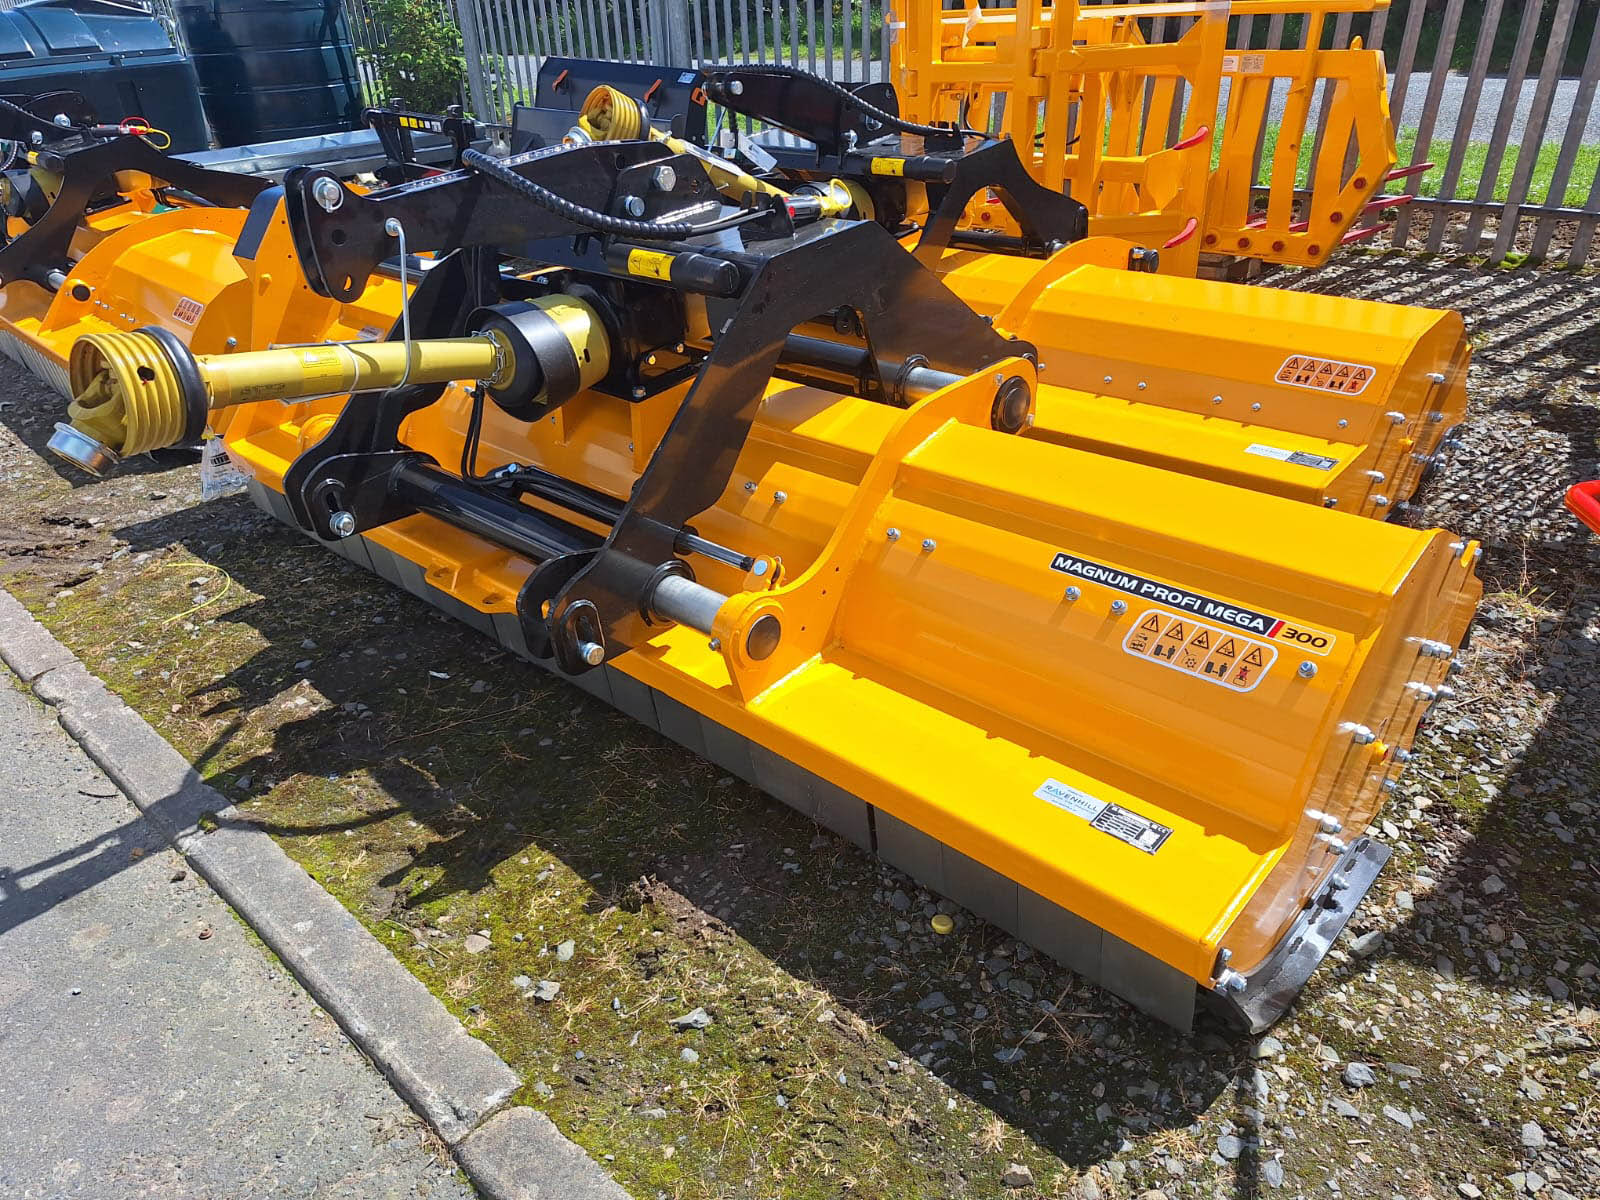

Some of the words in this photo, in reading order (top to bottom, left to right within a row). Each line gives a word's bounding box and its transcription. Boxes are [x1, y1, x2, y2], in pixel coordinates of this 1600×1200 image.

[1054, 556, 1138, 591] MAGNUM
[1141, 582, 1202, 610] PROFI
[1204, 604, 1265, 632] MEGA
[1281, 627, 1328, 649] 300
[1045, 784, 1098, 812] RAVENHILL
